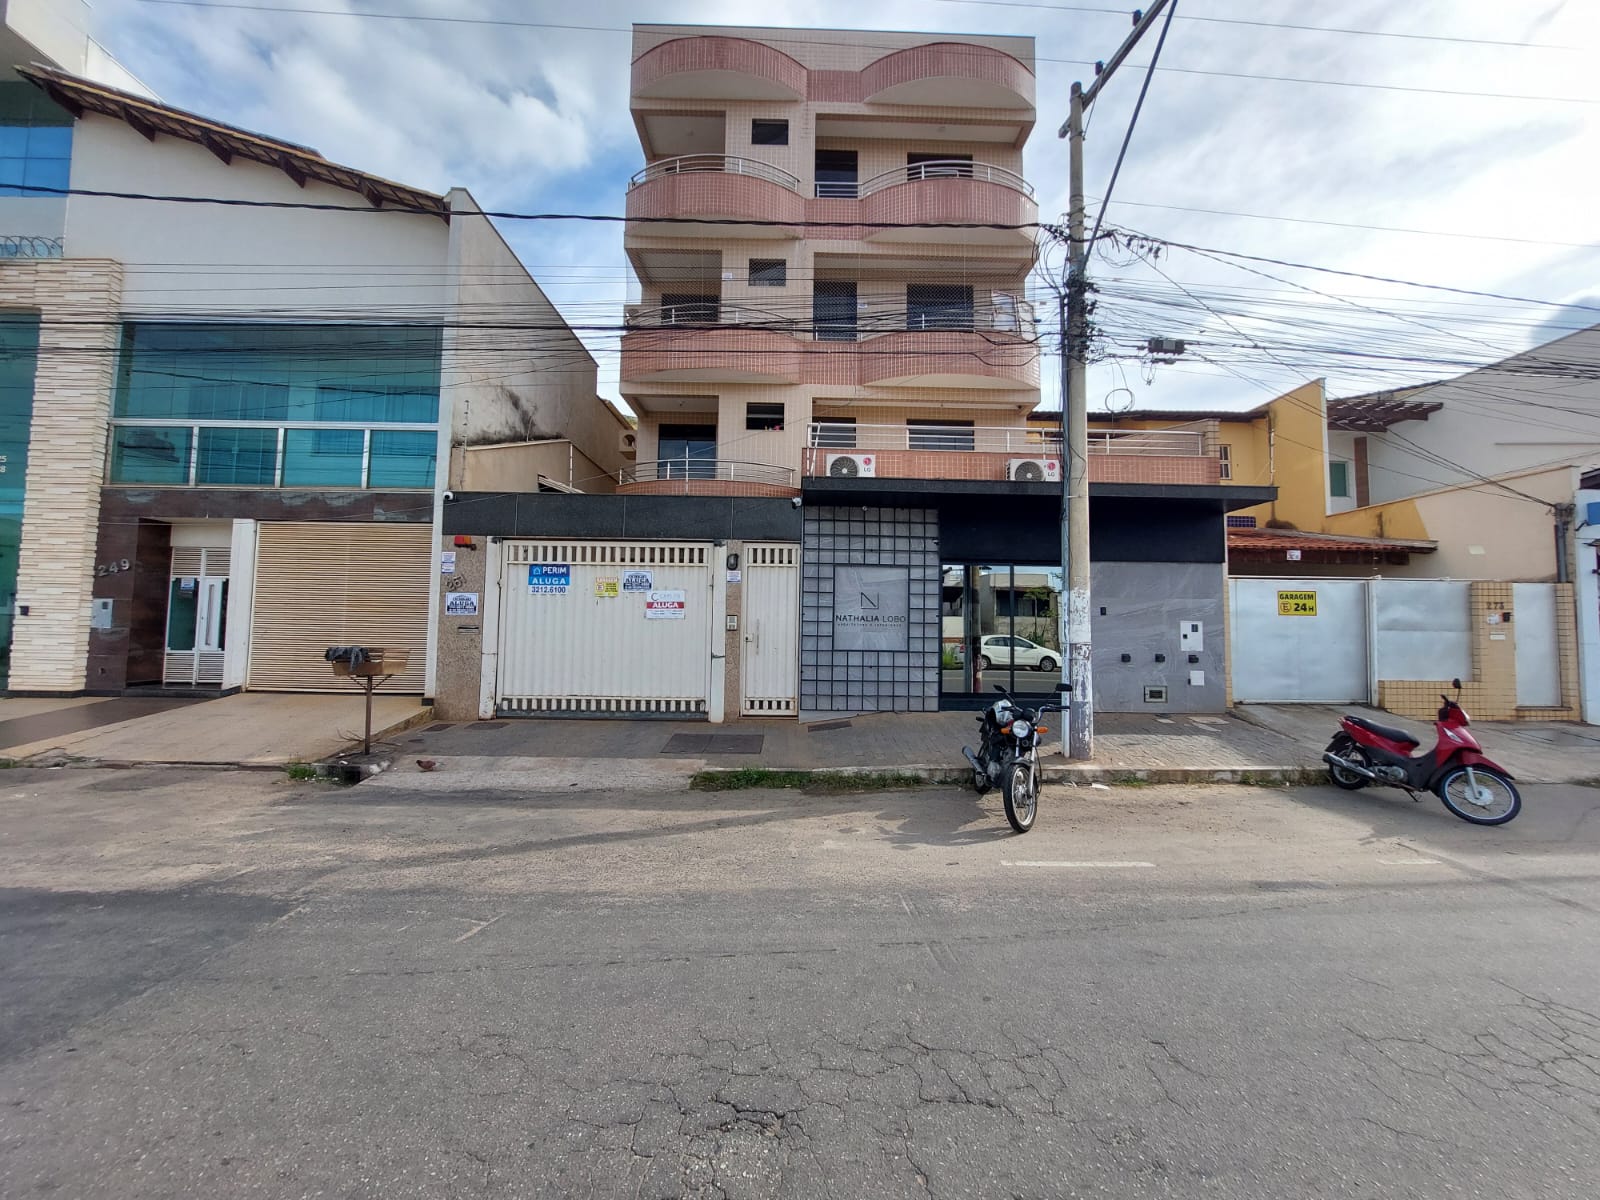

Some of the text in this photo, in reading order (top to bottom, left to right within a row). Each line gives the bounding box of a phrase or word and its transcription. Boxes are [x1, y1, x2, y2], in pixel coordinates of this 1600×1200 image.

[98, 558, 130, 577] 249
[542, 566, 567, 574] PERIM
[532, 577, 566, 585] ALUGA
[1279, 593, 1314, 601] GARAGEM
[835, 614, 906, 623] NATHALIA LOBO
